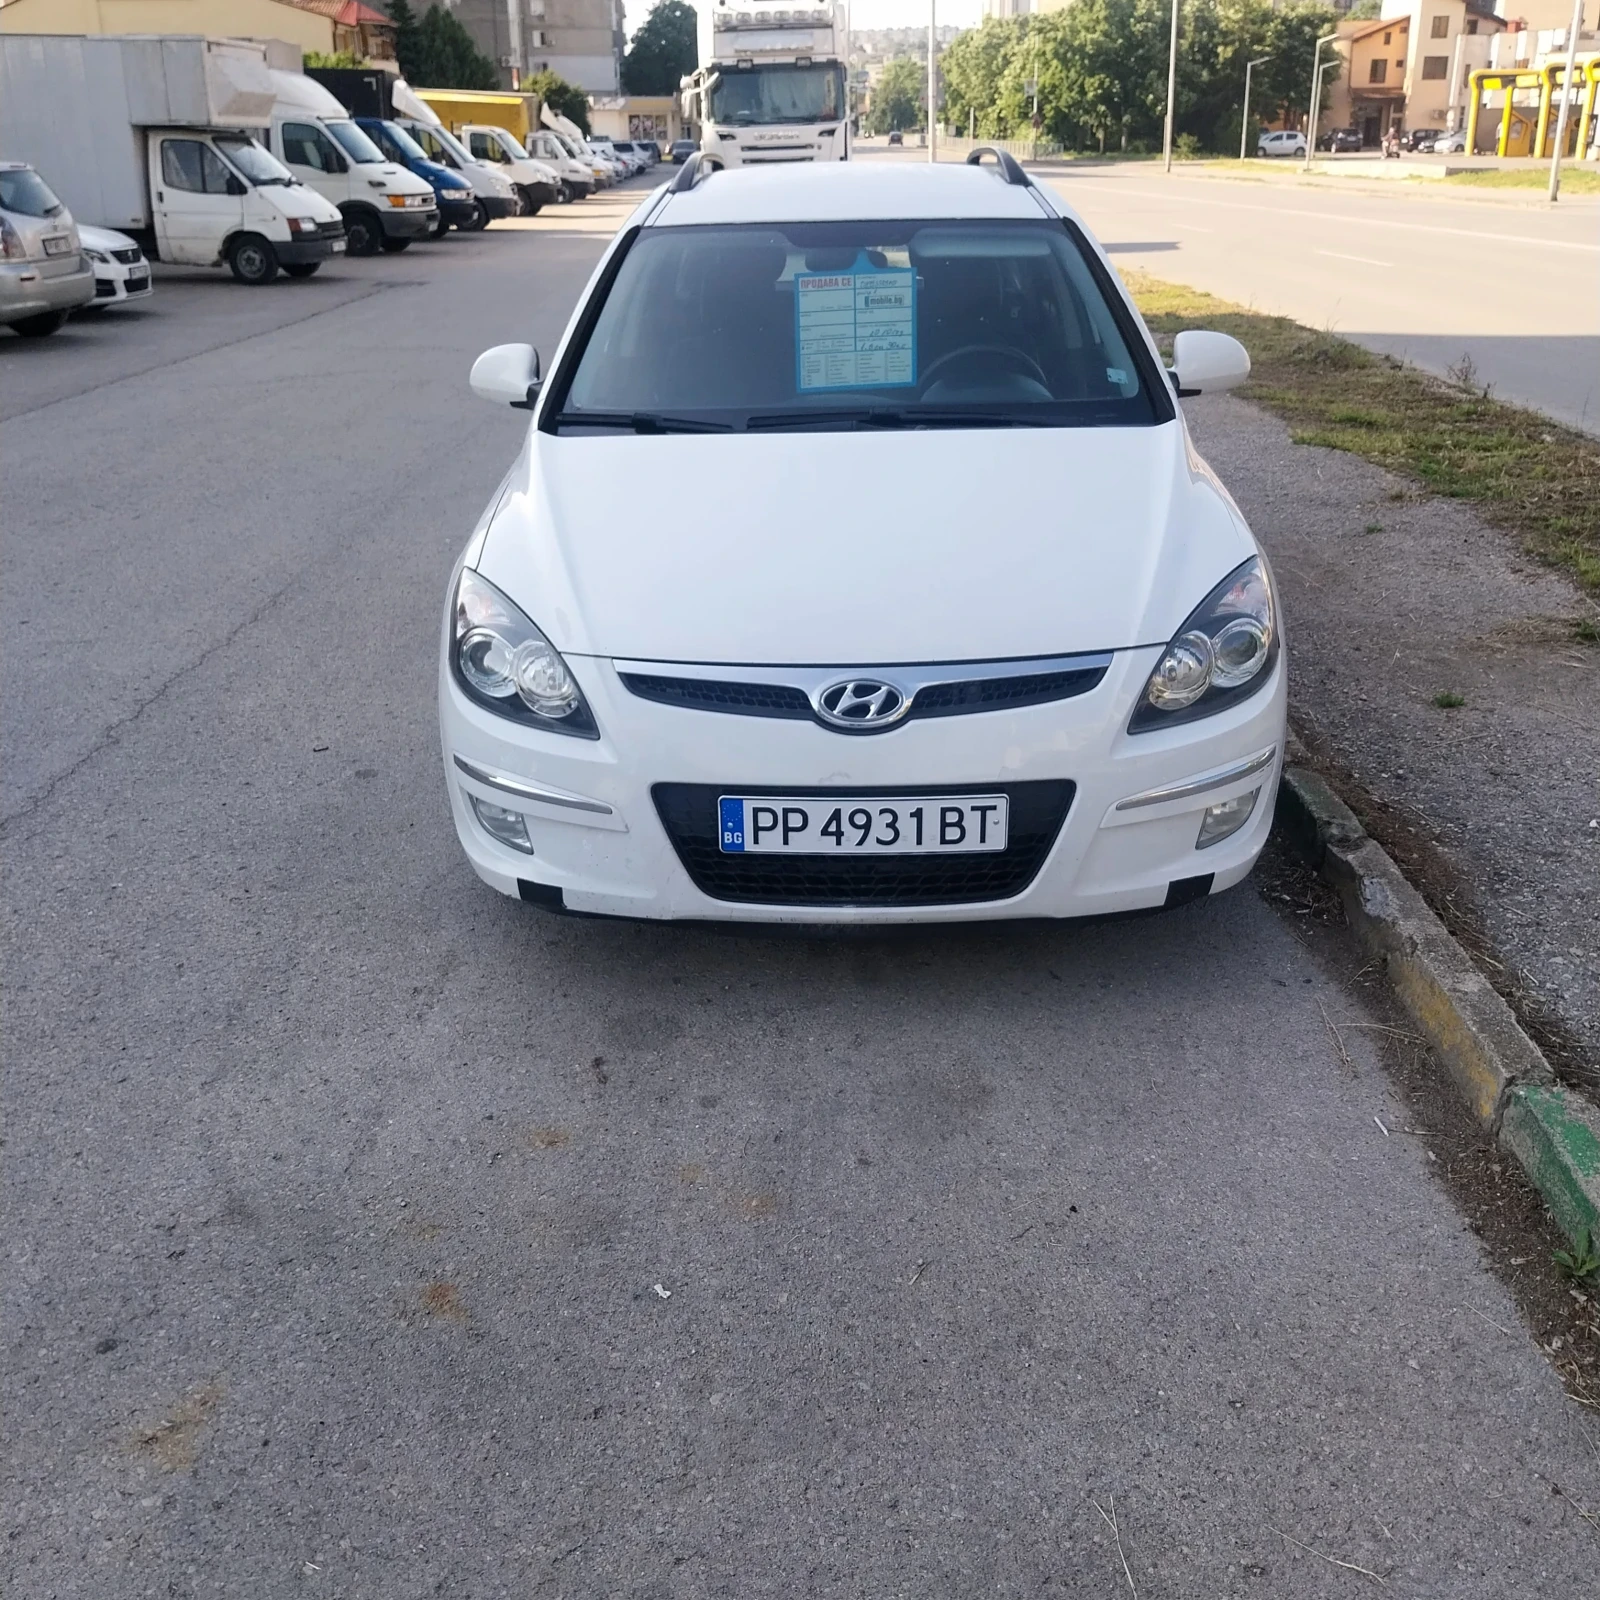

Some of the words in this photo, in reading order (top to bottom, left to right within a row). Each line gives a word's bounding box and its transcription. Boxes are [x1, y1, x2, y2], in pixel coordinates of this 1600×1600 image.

[800, 278, 840, 289] ПРОДАВА
[841, 277, 852, 287] СЕ
[870, 296, 903, 306] mobile.bg
[752, 806, 809, 846] PP
[820, 806, 923, 846] 4931
[939, 804, 998, 846] BT
[723, 832, 743, 844] BG
